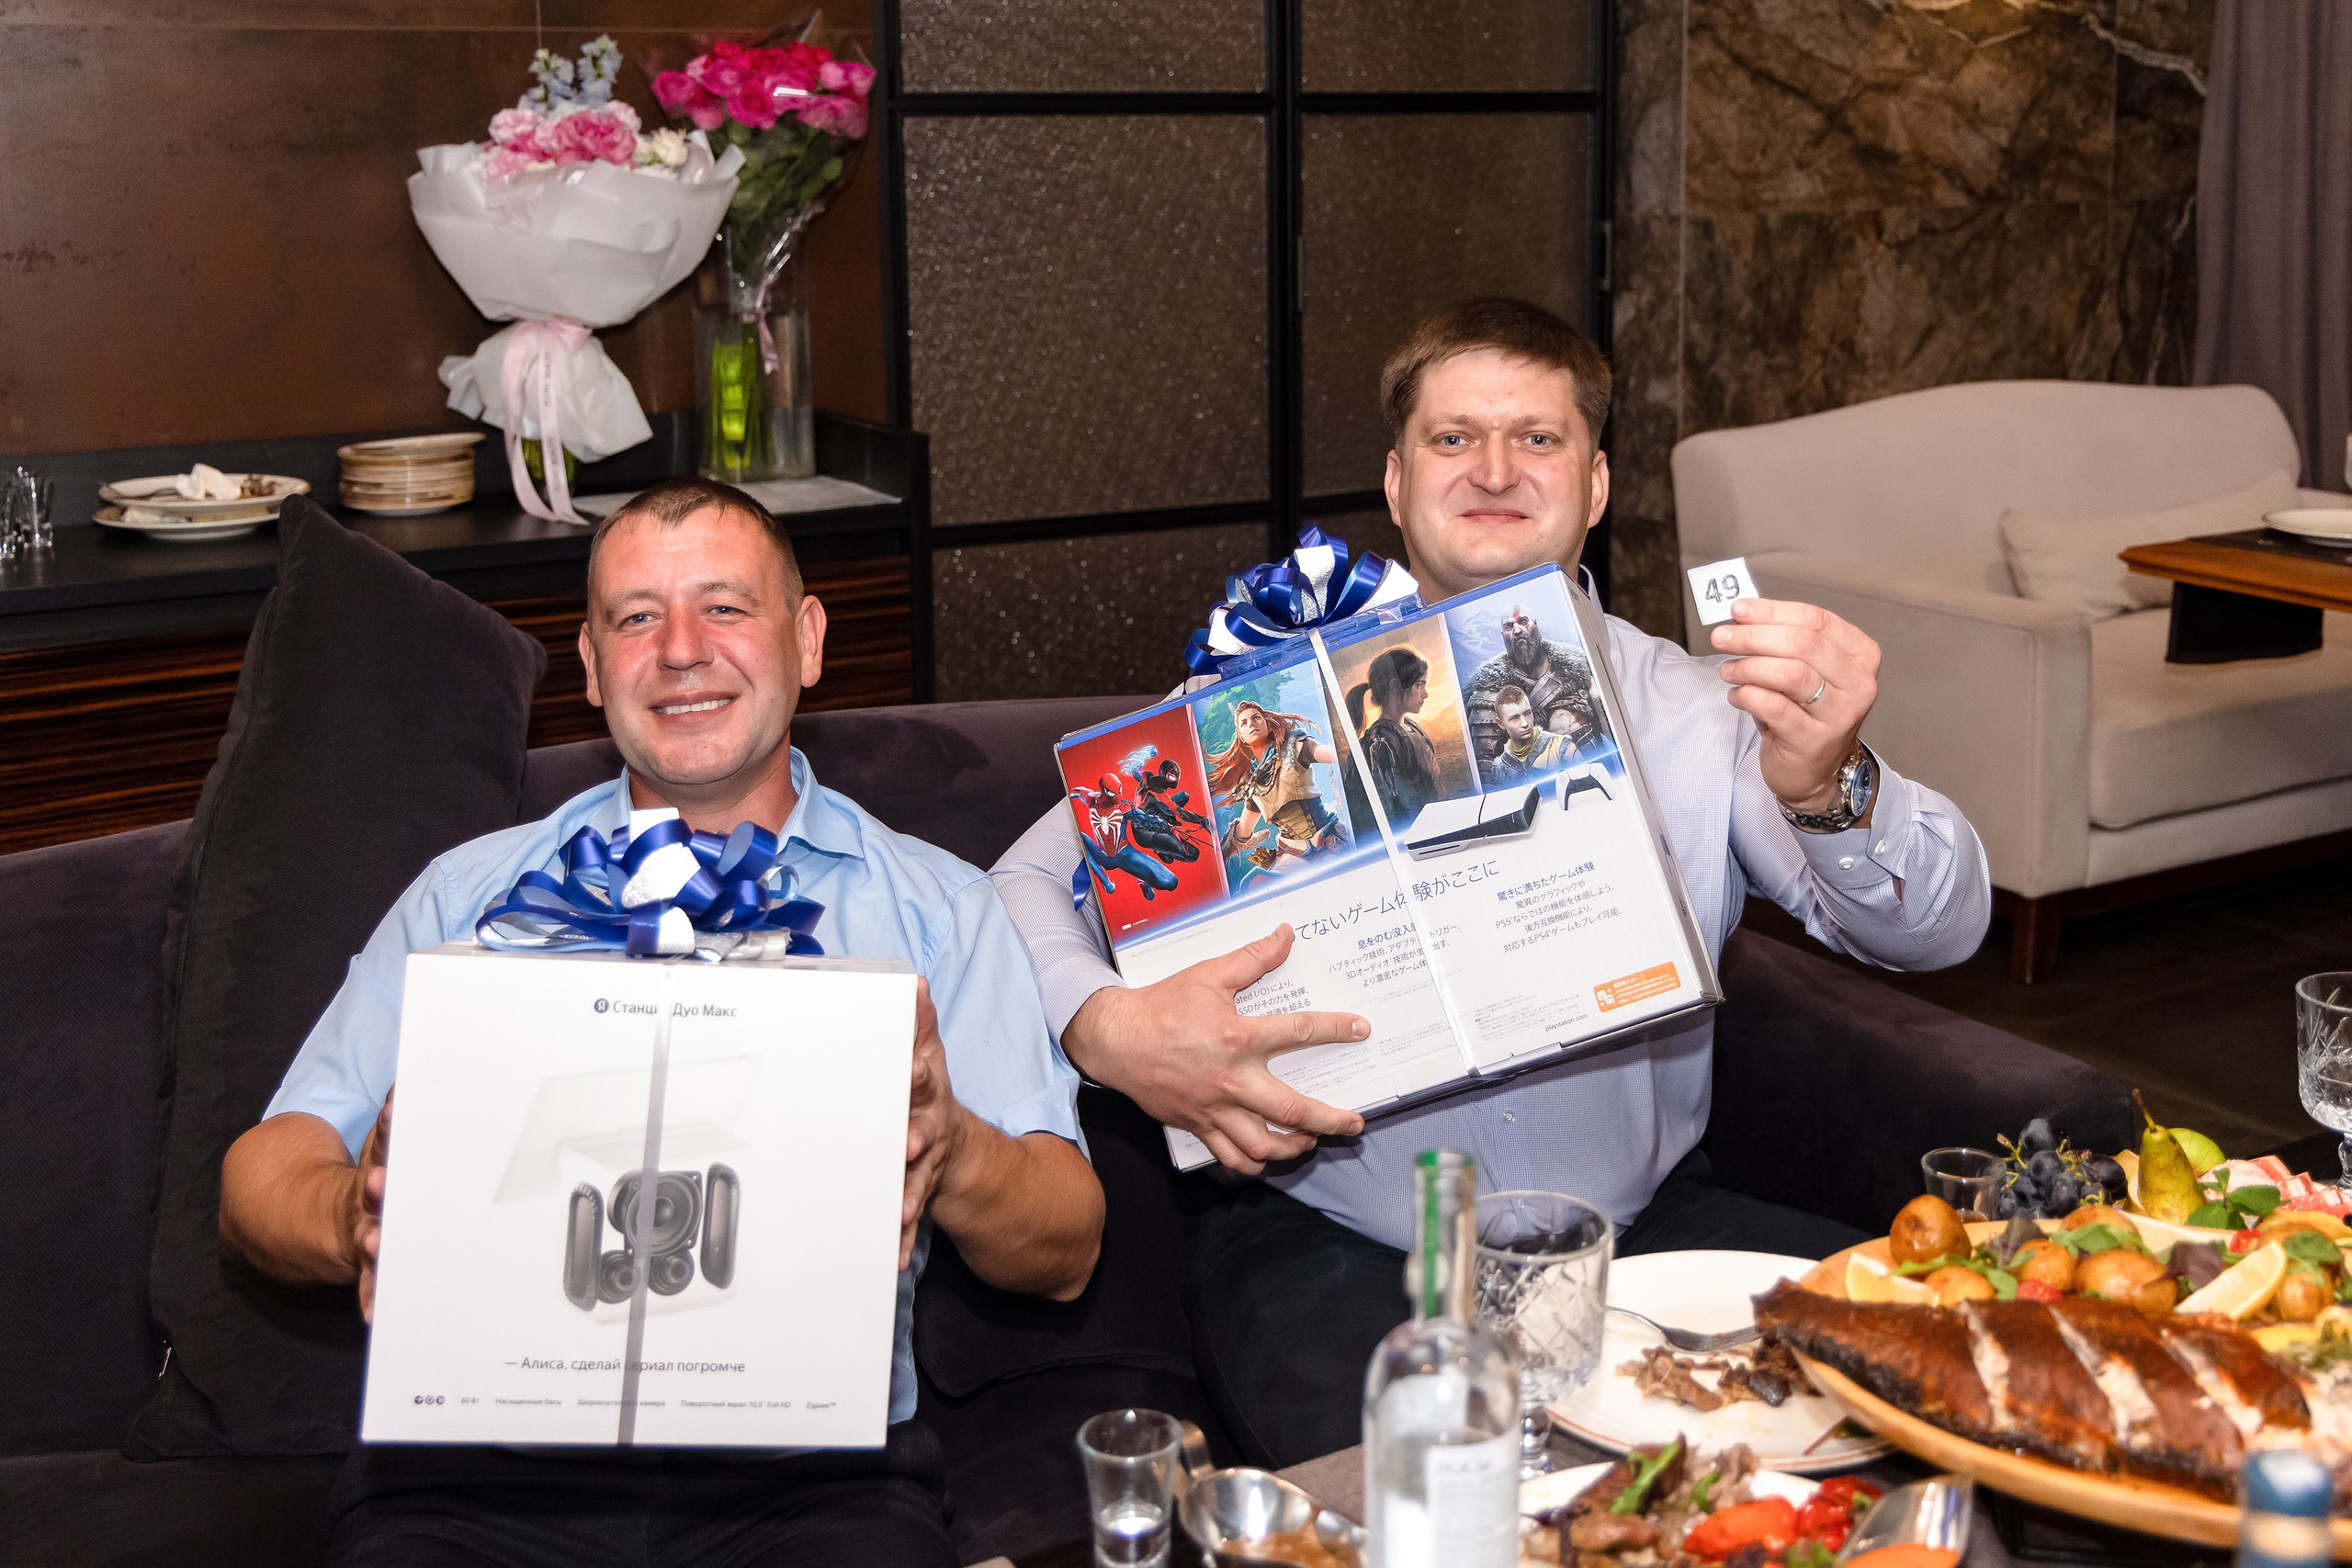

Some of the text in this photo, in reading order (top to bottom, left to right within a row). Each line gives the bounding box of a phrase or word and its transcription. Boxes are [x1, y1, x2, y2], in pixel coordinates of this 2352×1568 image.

[1706, 574, 1739, 603] 49
[1363, 959, 1429, 987] より濃密なゲーム体
[1235, 993, 1253, 1005] ated
[673, 1003, 699, 1017] Дуо
[703, 1004, 738, 1017] Макс
[1545, 1013, 1589, 1032] playstation.com
[521, 1358, 568, 1371] Алиса,
[571, 1359, 620, 1372] сделай
[677, 1361, 746, 1374] погромче
